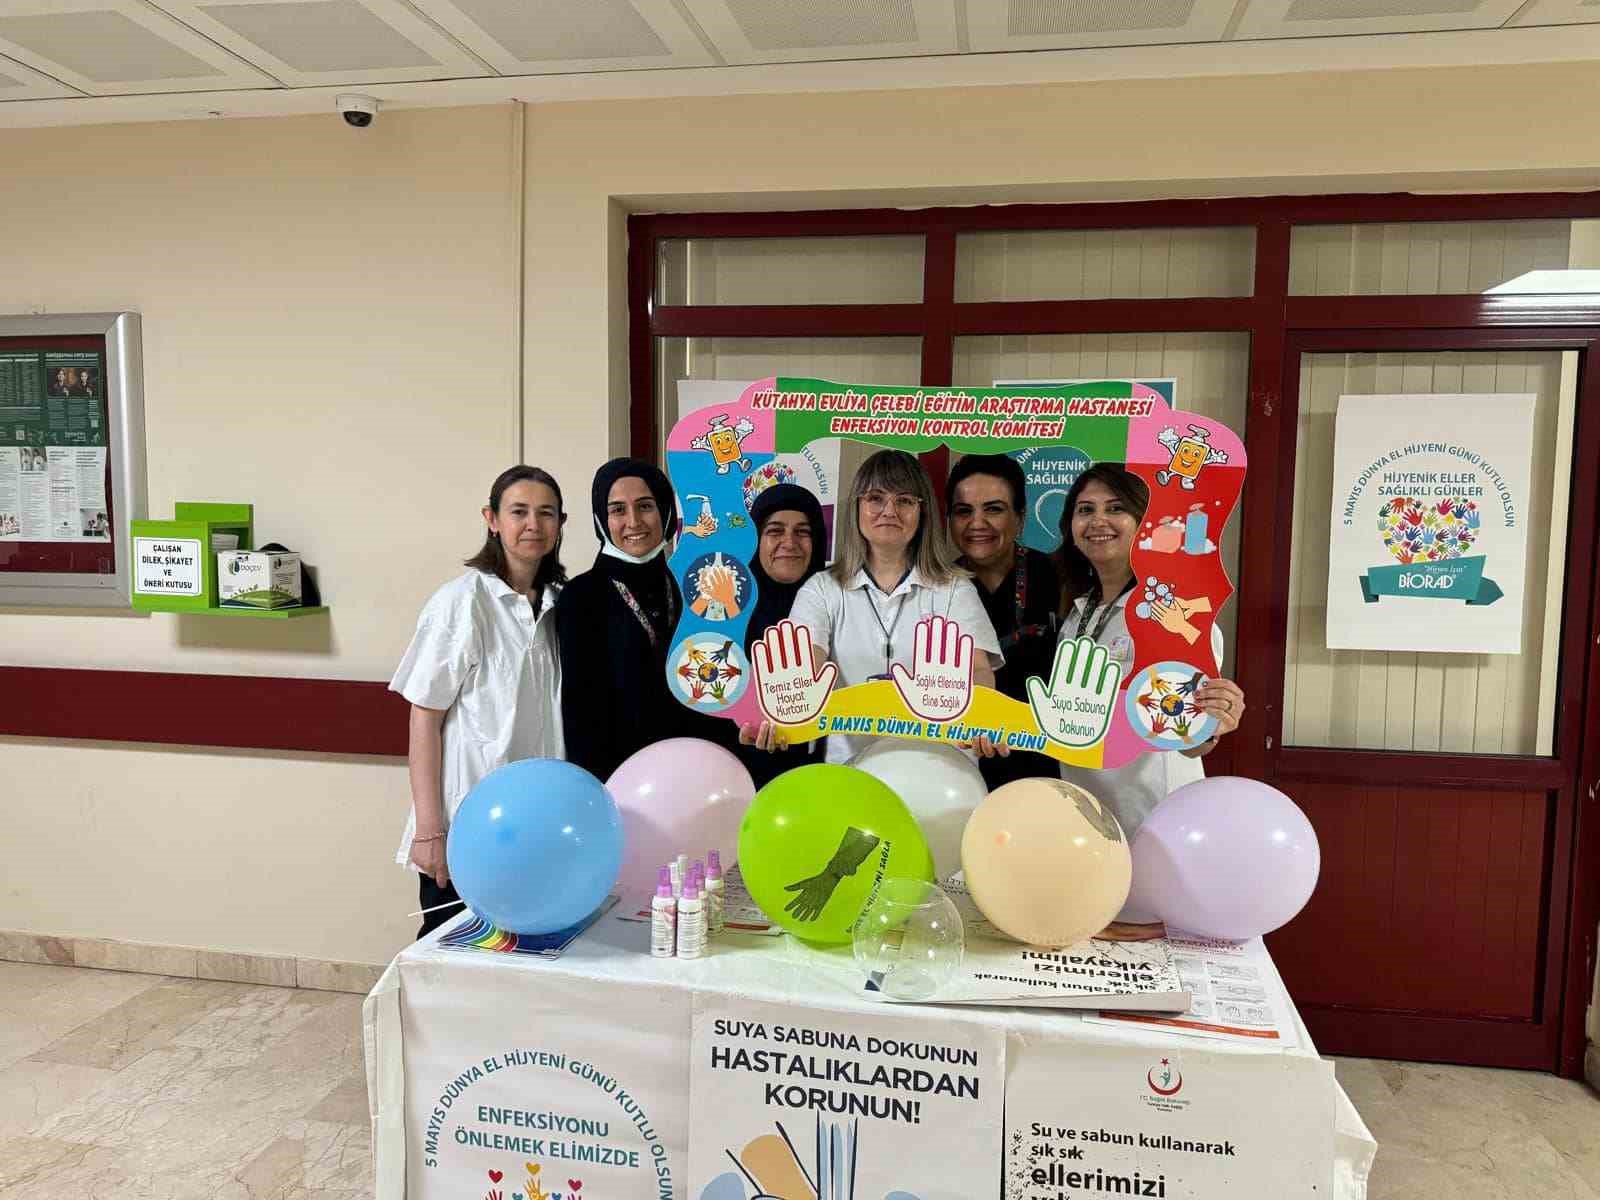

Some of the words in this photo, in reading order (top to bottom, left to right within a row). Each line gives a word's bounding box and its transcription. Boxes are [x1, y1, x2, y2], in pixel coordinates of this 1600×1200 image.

[751, 390, 816, 410] KÜTAHYA
[820, 390, 866, 411] EVLİYA
[871, 391, 922, 415] ÇELEBİ
[925, 392, 976, 414] EĞİTİM
[979, 396, 1064, 416] ARAŞTIRMA
[1068, 396, 1155, 416] HASTANESİ
[831, 416, 918, 434] ENFEKSİYON
[922, 420, 988, 437] KONTROL
[992, 417, 1065, 437] KOMİTESİ
[1032, 458, 1086, 471] HİJYENİK
[1026, 471, 1079, 485] SAĞLIKL
[1346, 486, 1362, 518] MAYIS
[1359, 456, 1389, 487] DÜNYA
[1389, 450, 1403, 461] EL
[1404, 442, 1446, 456] HİJYENİ
[1449, 446, 1480, 465] GÜNÜ
[1480, 461, 1507, 492] KUTLU
[1500, 492, 1516, 528] OLSUN
[1383, 471, 1437, 484] HİJYENİK
[1440, 472, 1476, 484] ELLER
[1378, 484, 1431, 497] SAĞLIKLI
[1434, 484, 1484, 497] GÜNLER
[165, 555, 193, 566] ŞİKAYET
[143, 578, 164, 588] ÖNERİ
[166, 580, 193, 590] KUTUSU
[764, 682, 791, 694] Temiz
[793, 676, 815, 689] Eller
[776, 691, 806, 706] Hayat
[1051, 694, 1072, 714] Suya
[1074, 696, 1106, 715] Sabuna
[776, 703, 810, 717] Kurtarır
[818, 716, 827, 731] 5
[831, 716, 871, 733] MAYIS
[877, 715, 922, 737] DÜNYA
[926, 723, 942, 738] EL
[1007, 731, 1049, 750] GÜNÜ
[1060, 718, 1095, 737] Dokunun
[1022, 951, 1152, 971] yıkayalım!
[974, 973, 1057, 989] kullanarak
[1034, 963, 1154, 982] ellerimizi
[714, 1019, 768, 1040] SUYA
[773, 1026, 861, 1051] SABUNA
[867, 1037, 978, 1066] DOKUNUN
[483, 1057, 503, 1073] EL
[504, 1049, 566, 1069] HİJYENİ
[569, 1063, 617, 1093] GÜNÜ
[711, 1046, 979, 1099] HASTALIKLARDAN
[440, 1066, 484, 1108] DÜNYA
[765, 1083, 921, 1124] KORUNUN!
[478, 1106, 609, 1137] ENFEKSİYONU
[615, 1090, 657, 1141] KUTLU
[425, 1107, 446, 1154] MAYIS
[1031, 1122, 1052, 1137] Su
[1056, 1128, 1077, 1140] ve
[1081, 1128, 1134, 1146] sabun
[1139, 1133, 1236, 1157] kullanarak
[455, 1126, 544, 1156] ÖNLEMEK
[549, 1141, 640, 1168] ELİMİZDE
[1031, 1143, 1055, 1157] sık
[1059, 1146, 1085, 1161] sık
[426, 1158, 437, 1168] 5
[651, 1144, 672, 1200] OLSUN
[1031, 1163, 1166, 1198] ellerimizi
